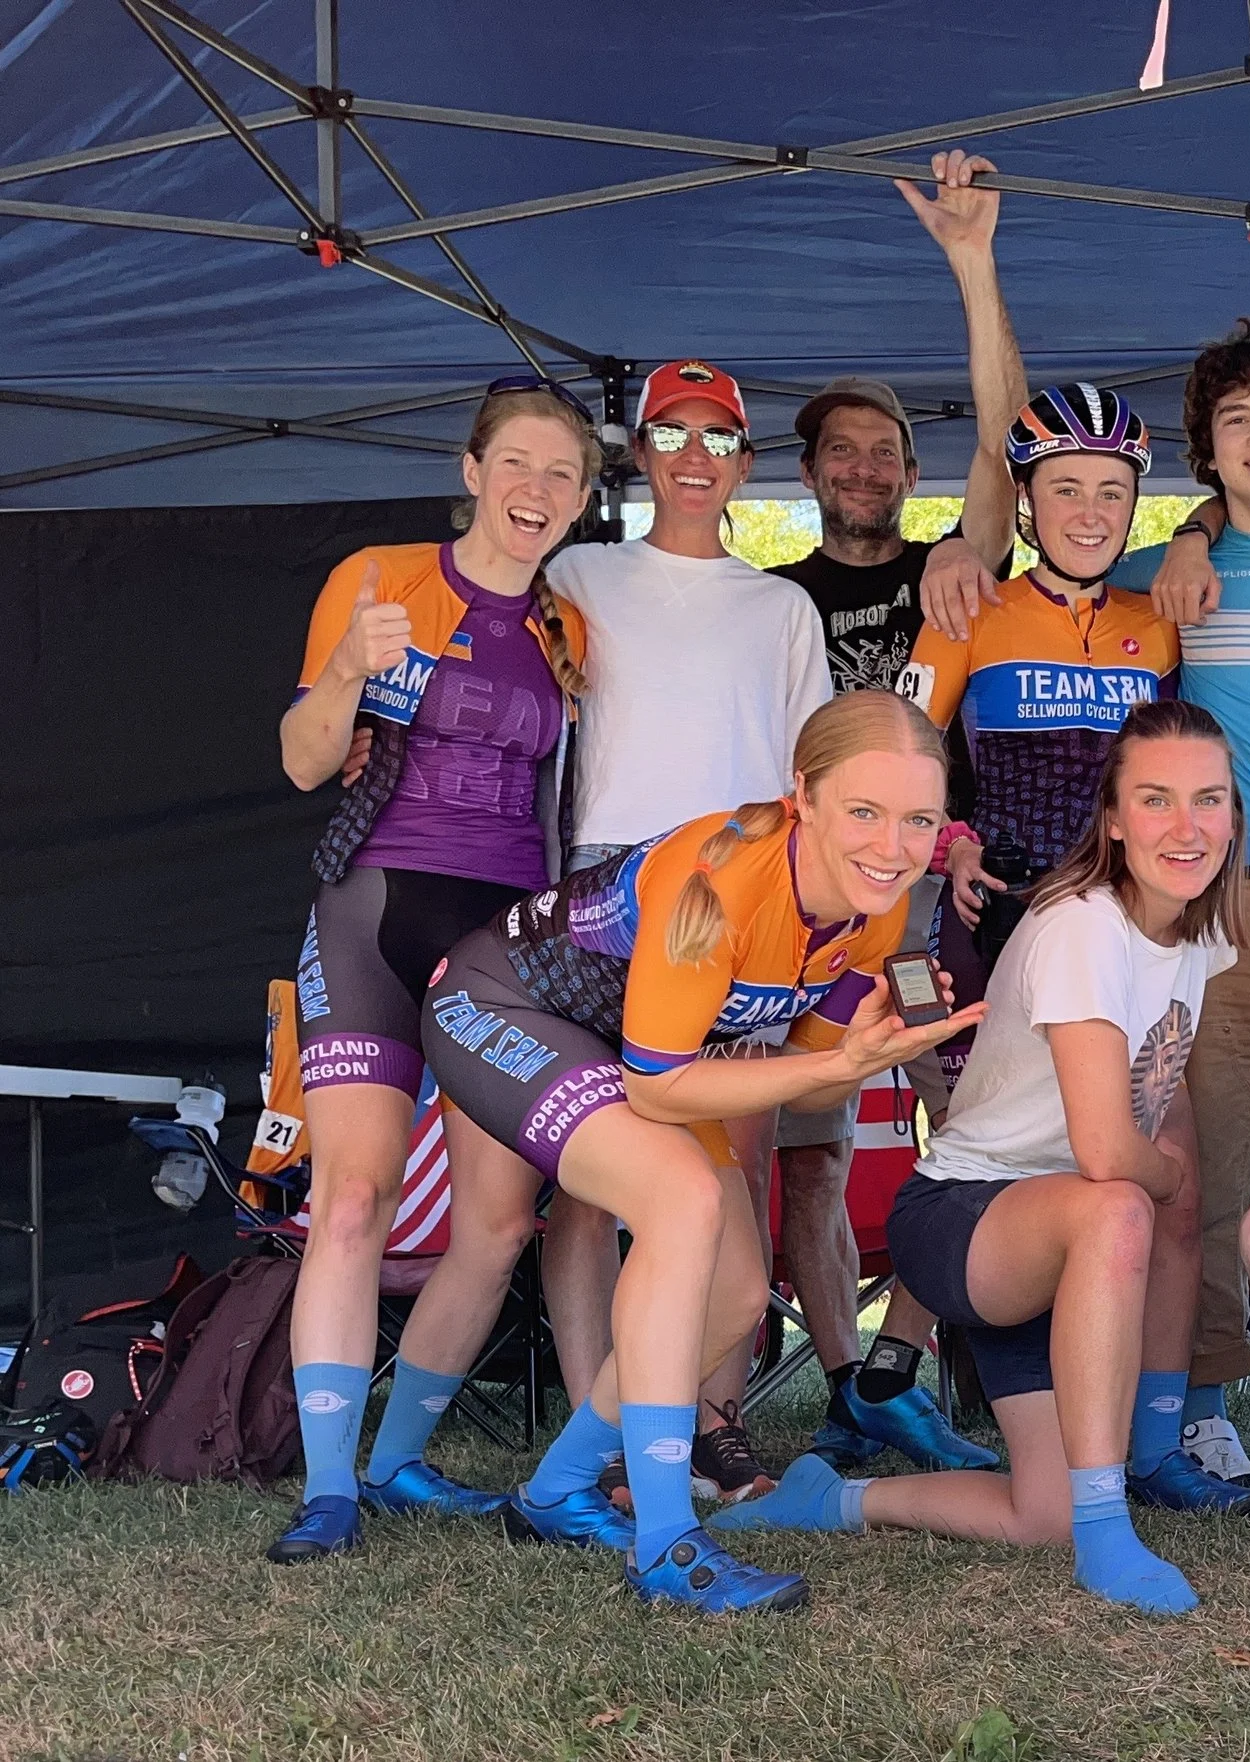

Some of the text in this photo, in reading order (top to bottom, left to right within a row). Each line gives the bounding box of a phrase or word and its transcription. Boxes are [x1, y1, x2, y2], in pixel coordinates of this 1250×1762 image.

[1029, 439, 1060, 454] LAZER
[1016, 669, 1152, 704] TEAM S&M
[1017, 703, 1082, 719] SELLWOOD
[1086, 706, 1121, 721] CYCLE
[719, 992, 788, 1023] EAM
[432, 990, 559, 1083] TEAM S&M
[524, 1063, 623, 1144] PORTLAN
[265, 1121, 293, 1146] 21
